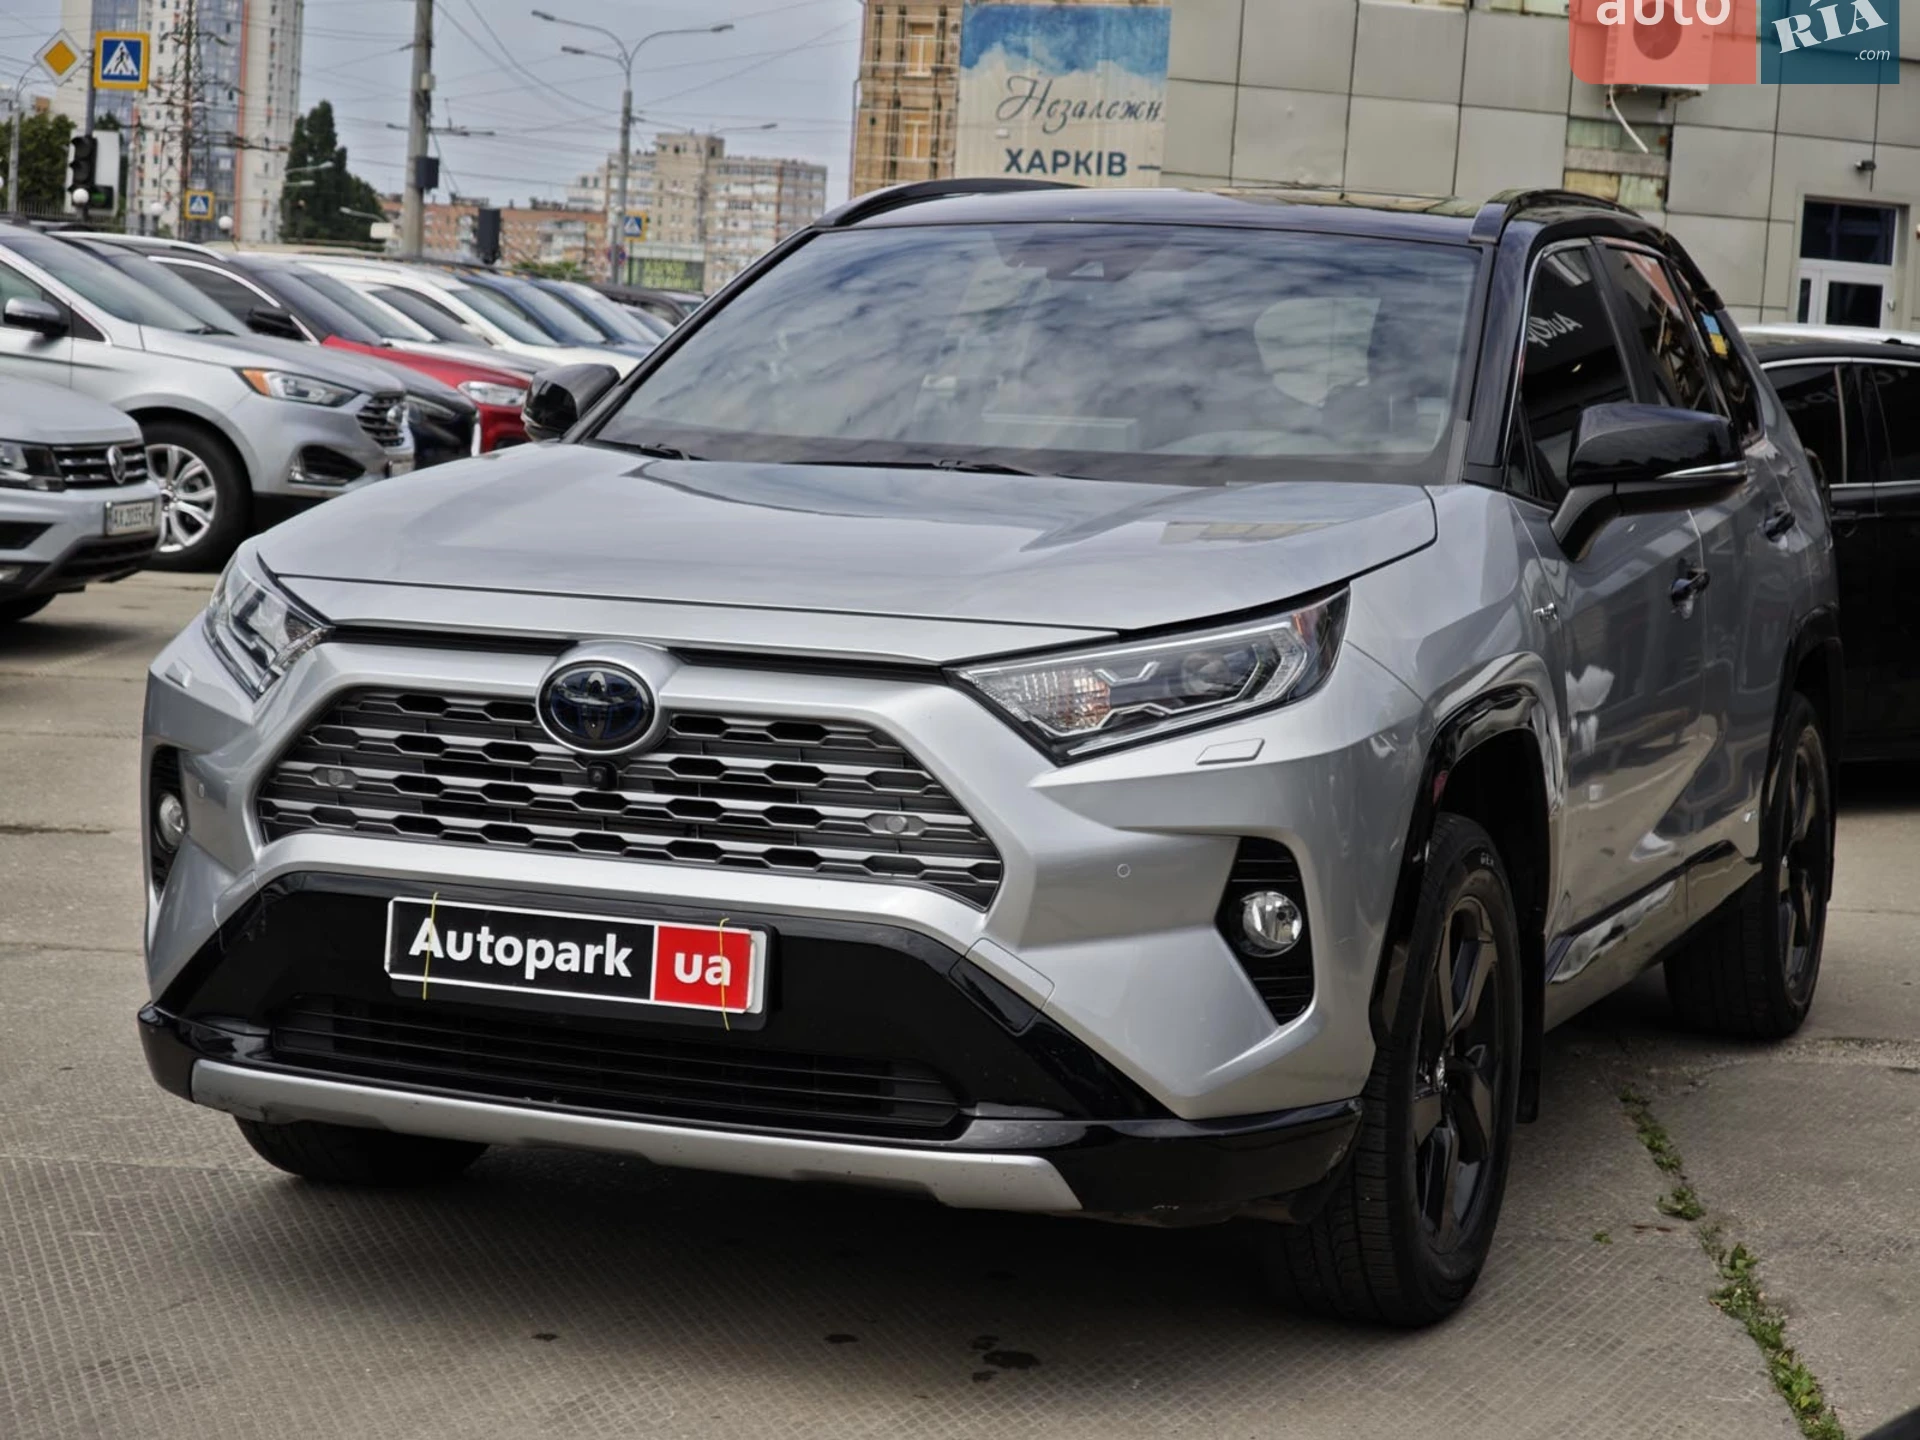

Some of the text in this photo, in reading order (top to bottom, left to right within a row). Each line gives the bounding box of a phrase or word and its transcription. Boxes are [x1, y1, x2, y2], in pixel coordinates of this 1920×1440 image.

[1003, 148, 1128, 177] ХАРКІВ
[408, 917, 733, 987] Autopark ua
